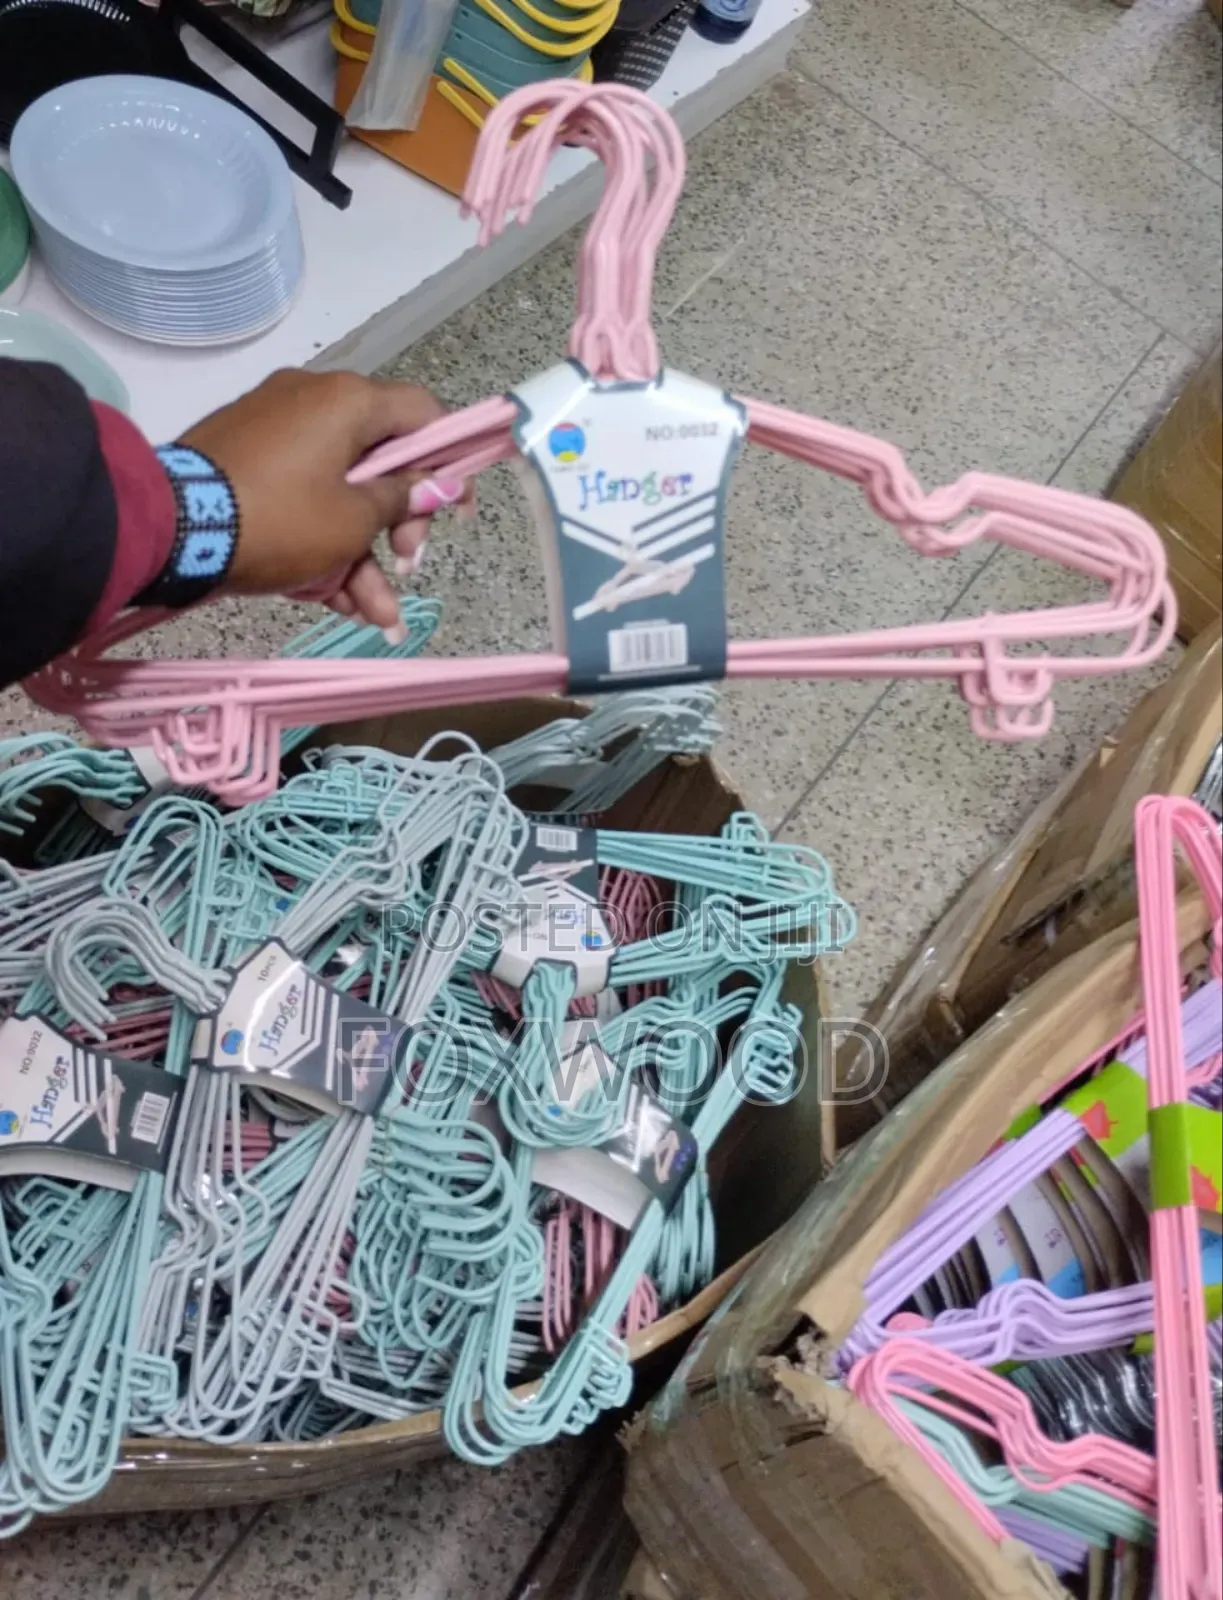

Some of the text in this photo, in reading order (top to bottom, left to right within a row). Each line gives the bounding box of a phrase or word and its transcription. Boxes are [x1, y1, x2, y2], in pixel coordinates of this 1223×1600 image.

[577, 469, 694, 512] Hanger
[259, 984, 302, 1056] Hanger
[30, 1055, 70, 1130] Hanger
